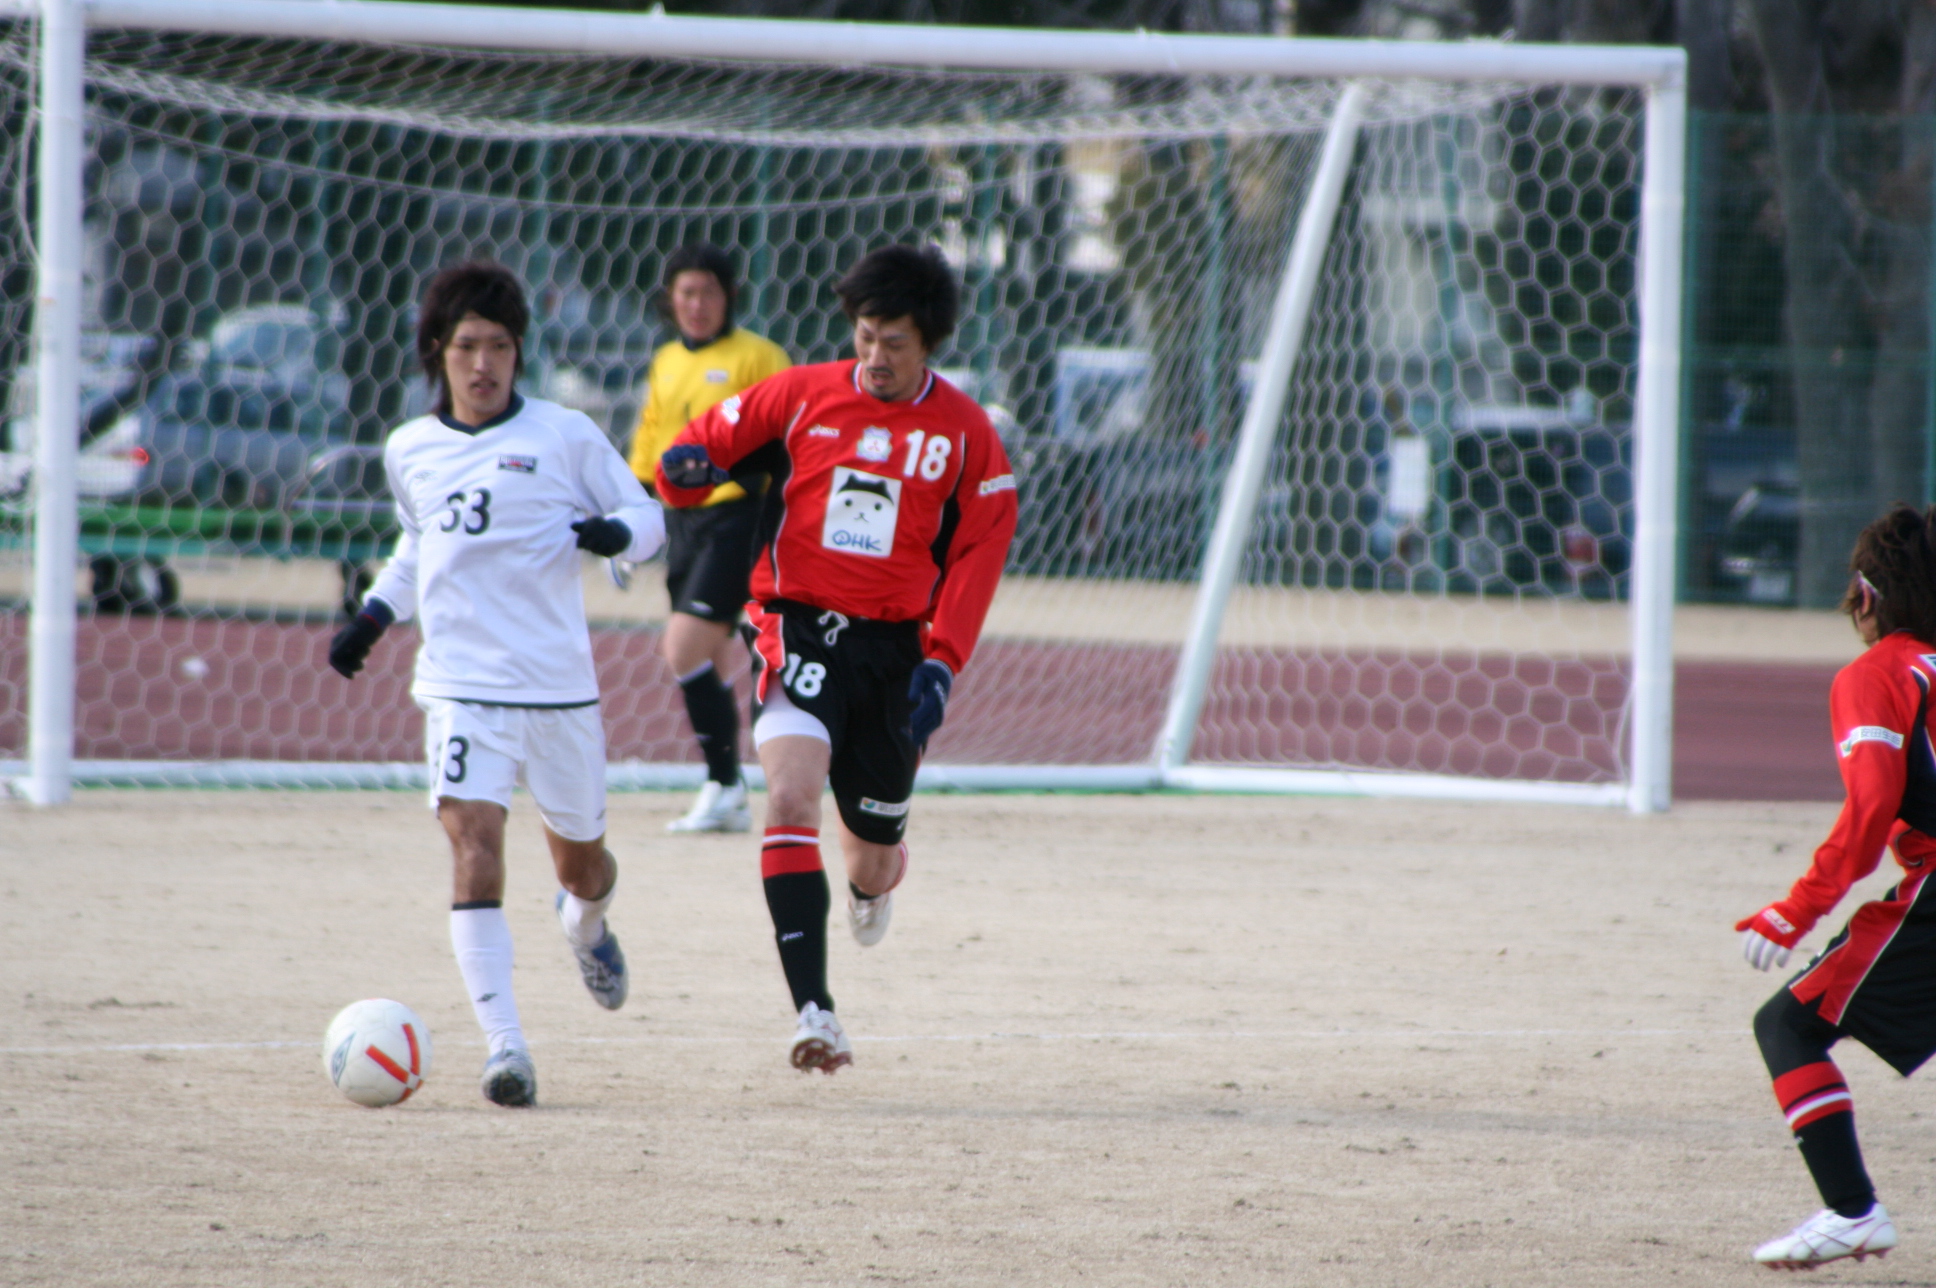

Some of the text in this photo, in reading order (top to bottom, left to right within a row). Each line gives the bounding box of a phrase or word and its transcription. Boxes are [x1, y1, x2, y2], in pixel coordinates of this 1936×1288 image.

[903, 429, 952, 481] 18
[784, 653, 827, 698] 18
[437, 735, 470, 784] 3
